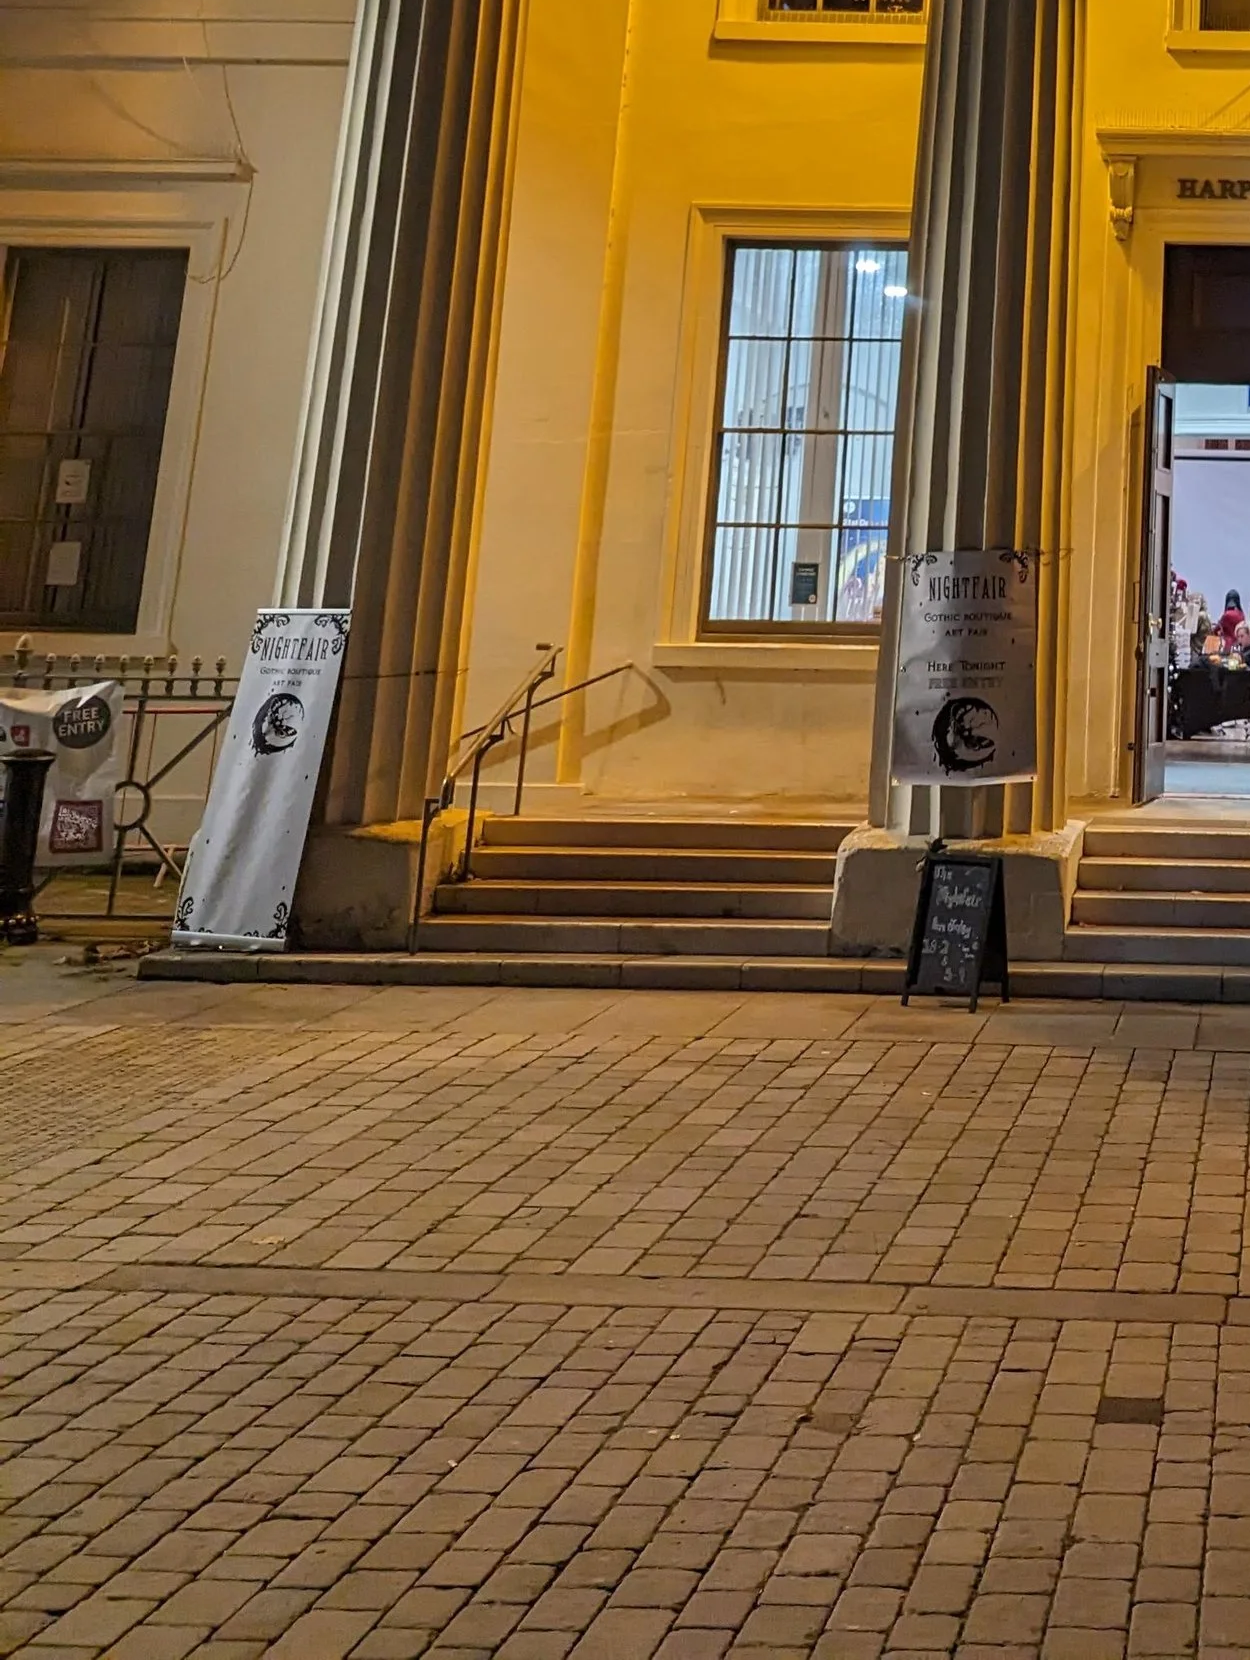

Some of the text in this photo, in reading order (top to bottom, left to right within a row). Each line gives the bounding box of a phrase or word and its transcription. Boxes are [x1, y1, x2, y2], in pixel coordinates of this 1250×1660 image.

[929, 576, 1007, 602] NIGHTFAIR
[924, 612, 960, 622] GOTHIC
[260, 636, 329, 662] NIGHTFAIR
[927, 661, 1006, 672] HERE TONIGHT
[63, 707, 100, 723] FREE
[58, 719, 104, 737] ENTRY
